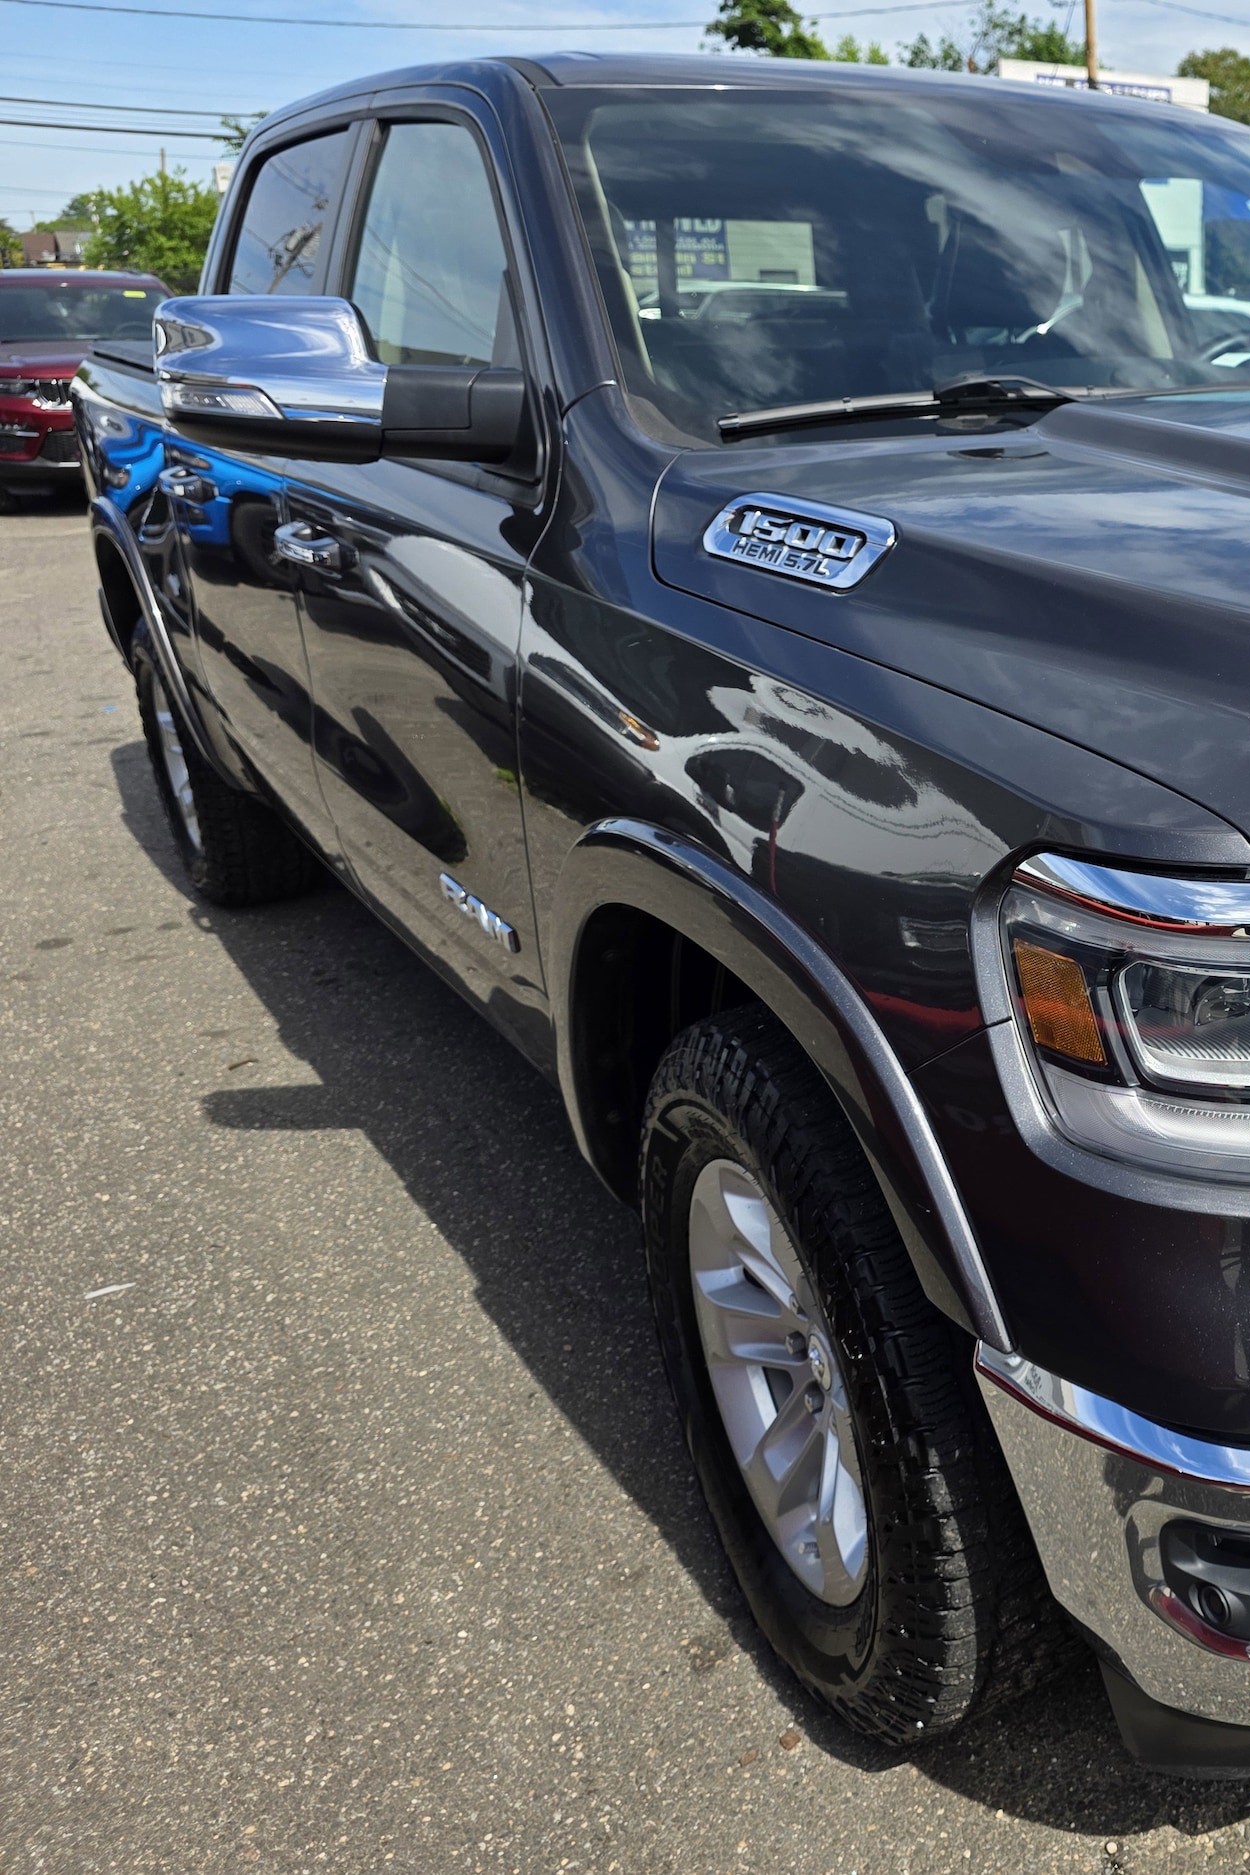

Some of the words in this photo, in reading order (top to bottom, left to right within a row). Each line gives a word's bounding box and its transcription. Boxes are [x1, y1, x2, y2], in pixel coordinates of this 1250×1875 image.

[738, 511, 863, 558] 1500
[733, 541, 782, 564] HEMI
[783, 552, 829, 576] 5.7L
[440, 872, 521, 953] RAM
